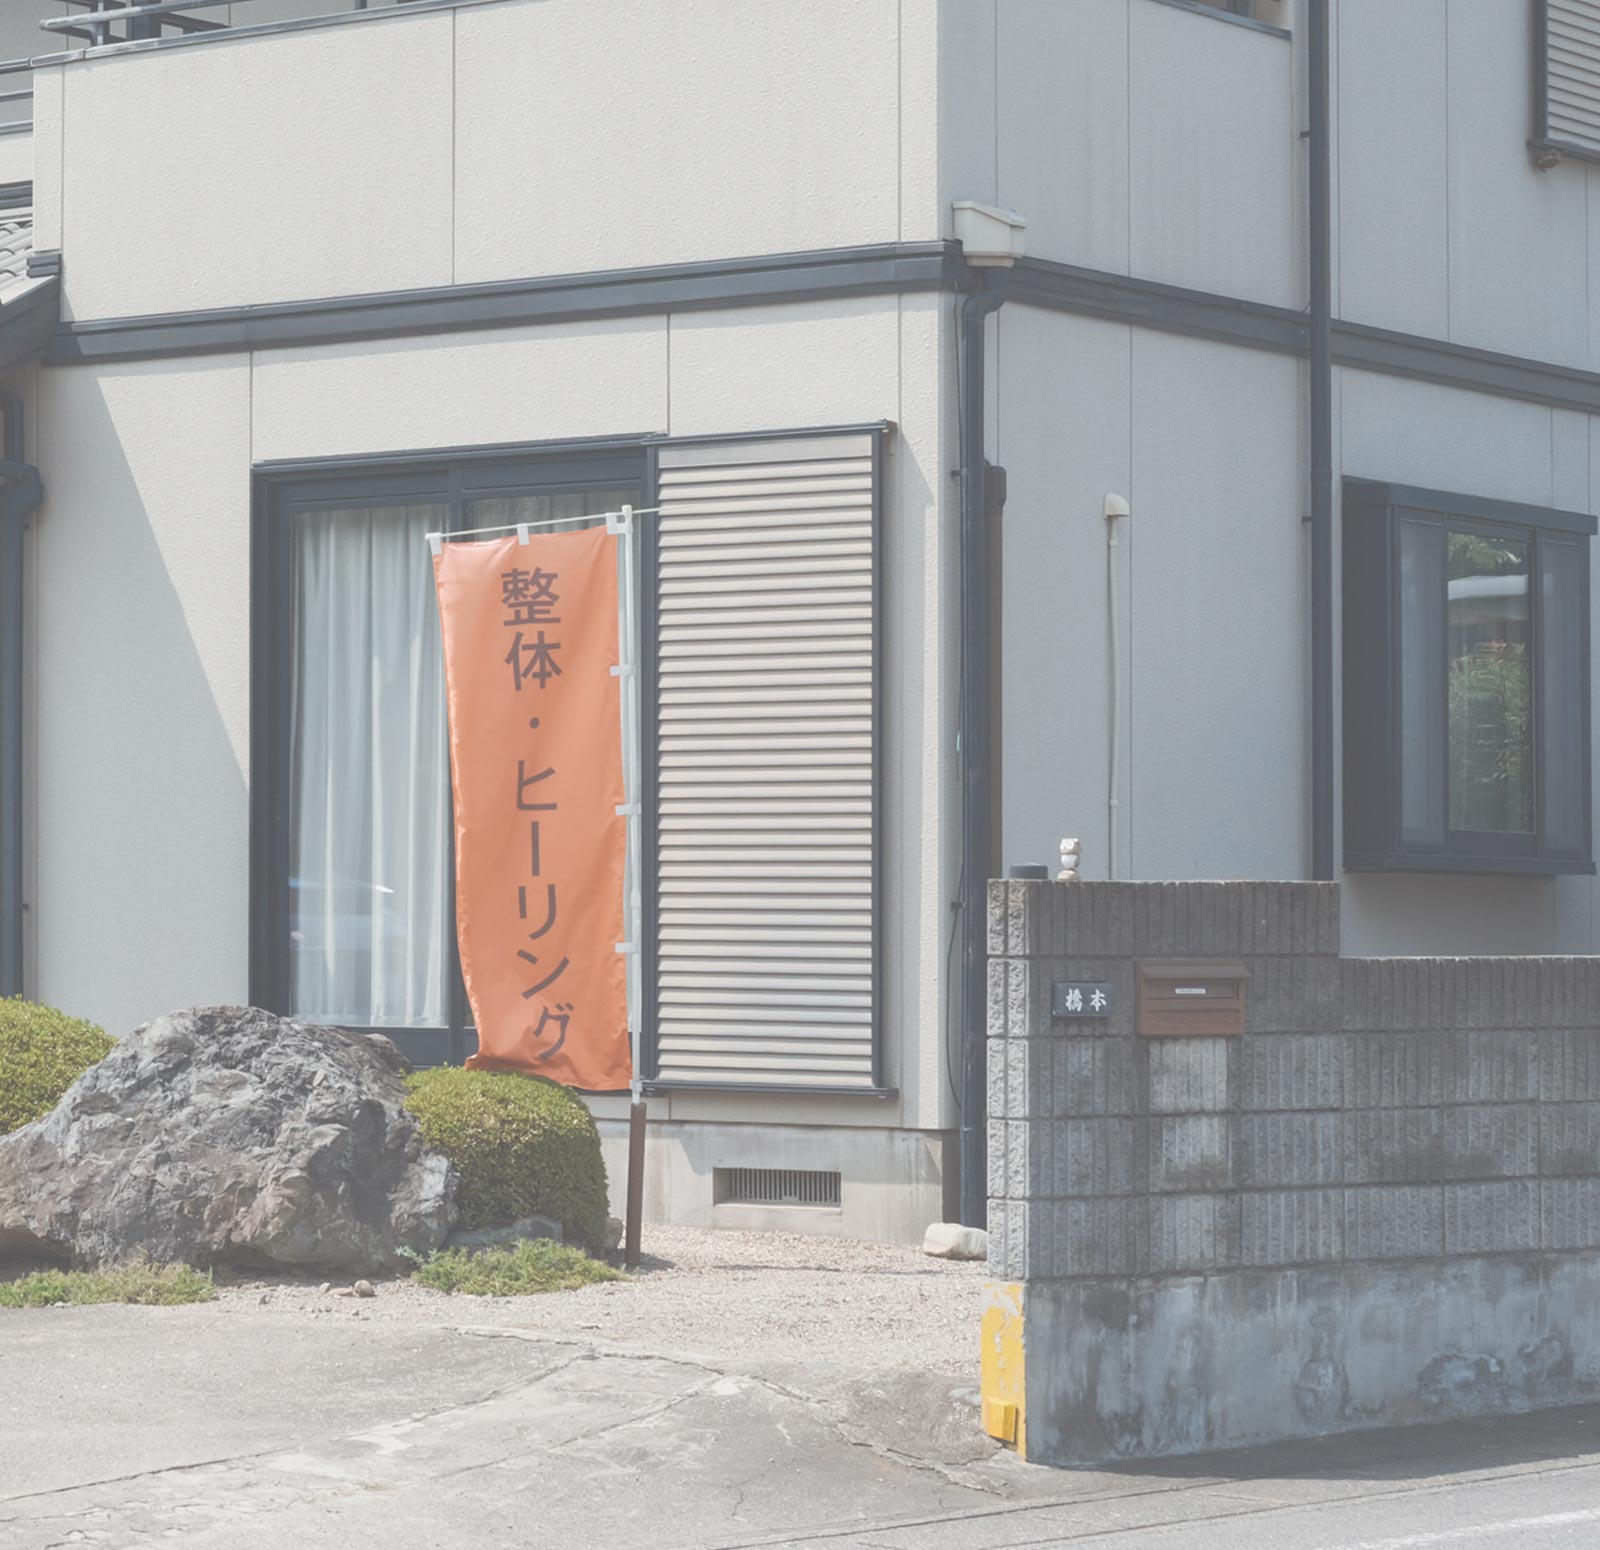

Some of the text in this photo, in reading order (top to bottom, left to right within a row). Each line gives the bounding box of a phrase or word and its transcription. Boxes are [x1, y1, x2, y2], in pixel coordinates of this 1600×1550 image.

[501, 567, 574, 1060] 整体・ヒーリング
[1064, 987, 1107, 1012] 橋本
